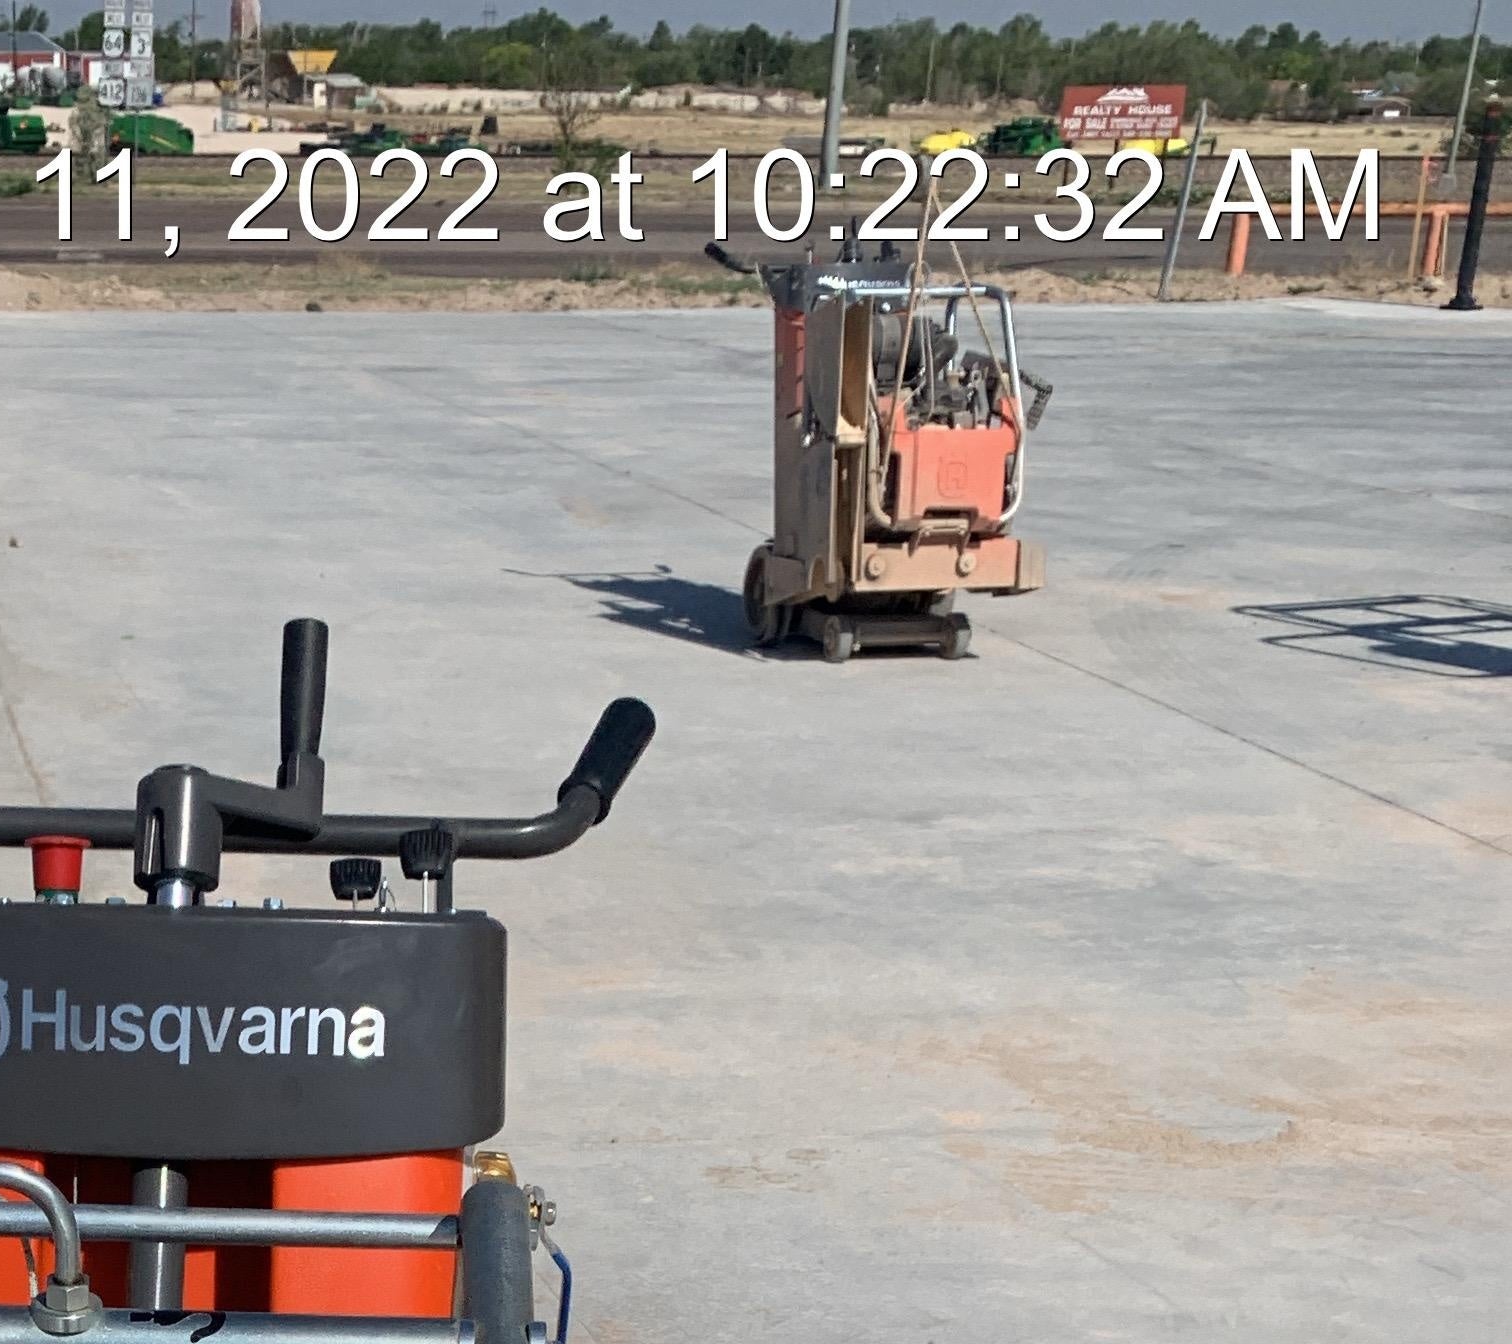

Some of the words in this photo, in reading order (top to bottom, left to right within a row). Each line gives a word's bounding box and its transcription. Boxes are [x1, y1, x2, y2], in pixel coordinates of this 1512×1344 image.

[1072, 105, 1122, 116] REALTY
[1128, 104, 1173, 115] HOUSE
[20, 988, 386, 1065] Husqvarna
